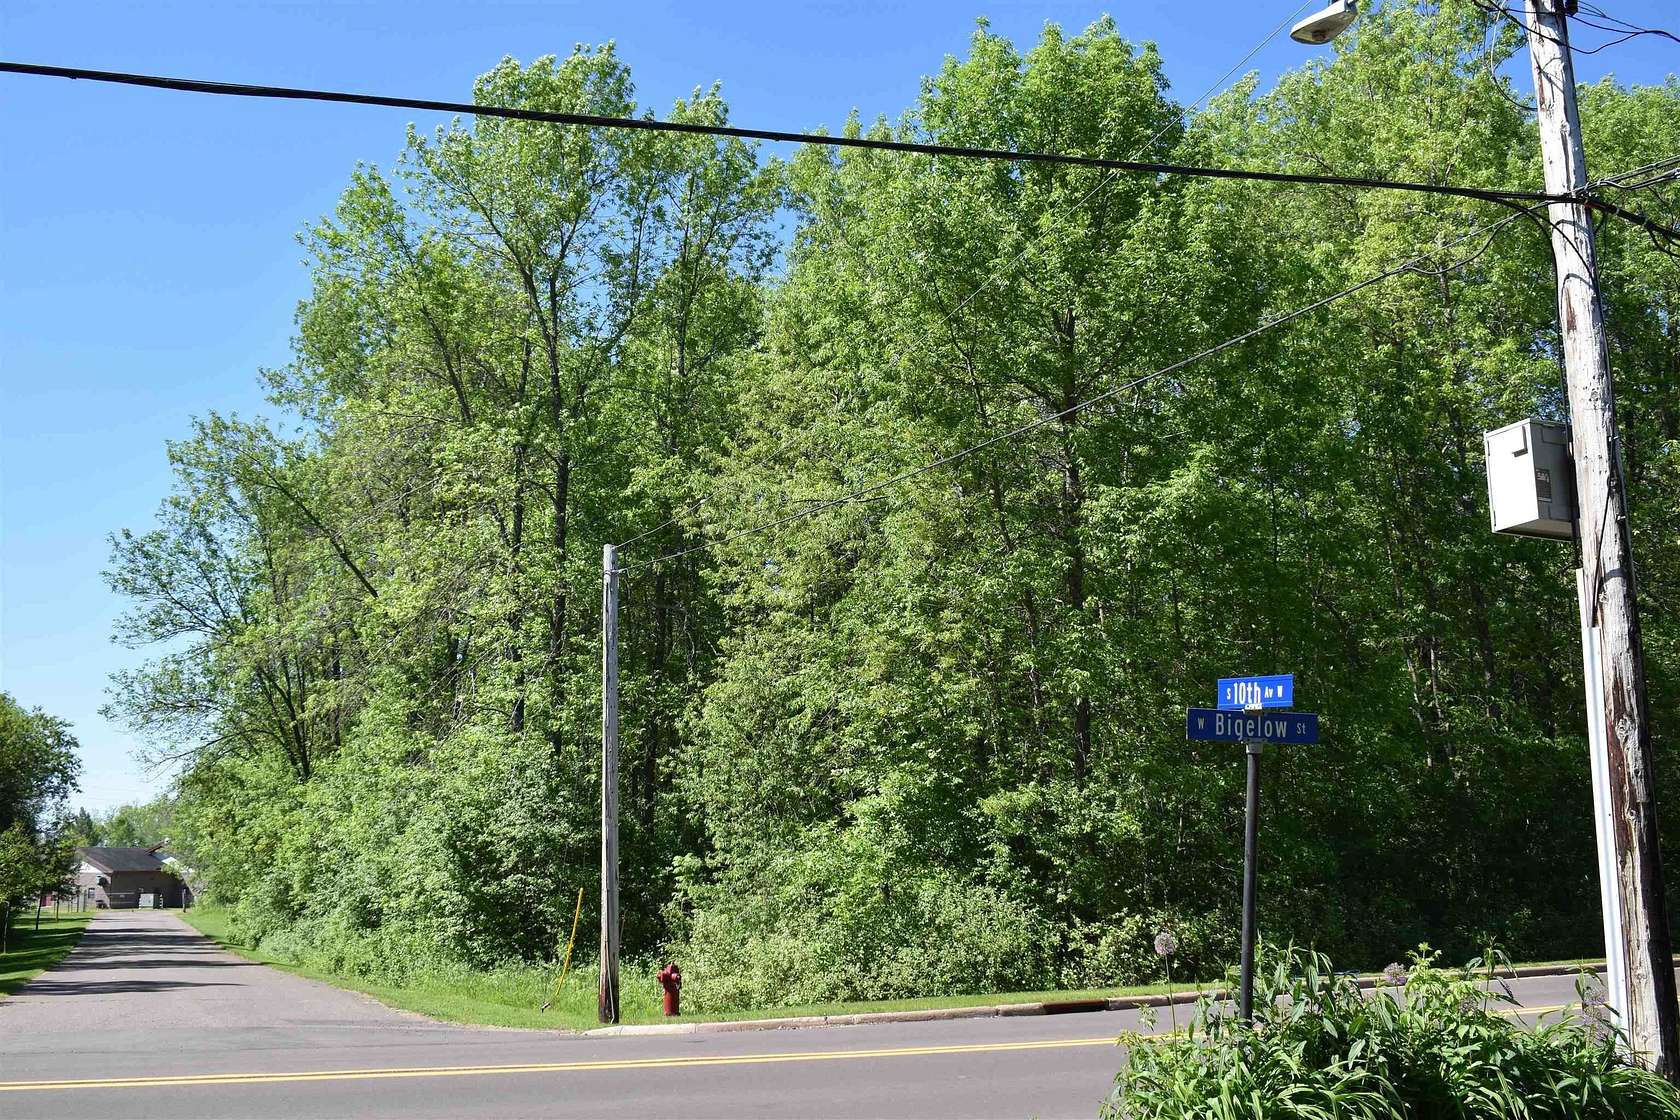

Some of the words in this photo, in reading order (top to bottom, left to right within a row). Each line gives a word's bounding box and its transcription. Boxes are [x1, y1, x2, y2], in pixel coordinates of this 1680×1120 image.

[1226, 687, 1231, 700] S
[1233, 682, 1261, 704] 10th
[1264, 686, 1273, 698] Av
[1277, 685, 1283, 698] W
[1197, 717, 1205, 729] W
[1215, 713, 1287, 740] Bigelow
[1296, 722, 1306, 735] St
